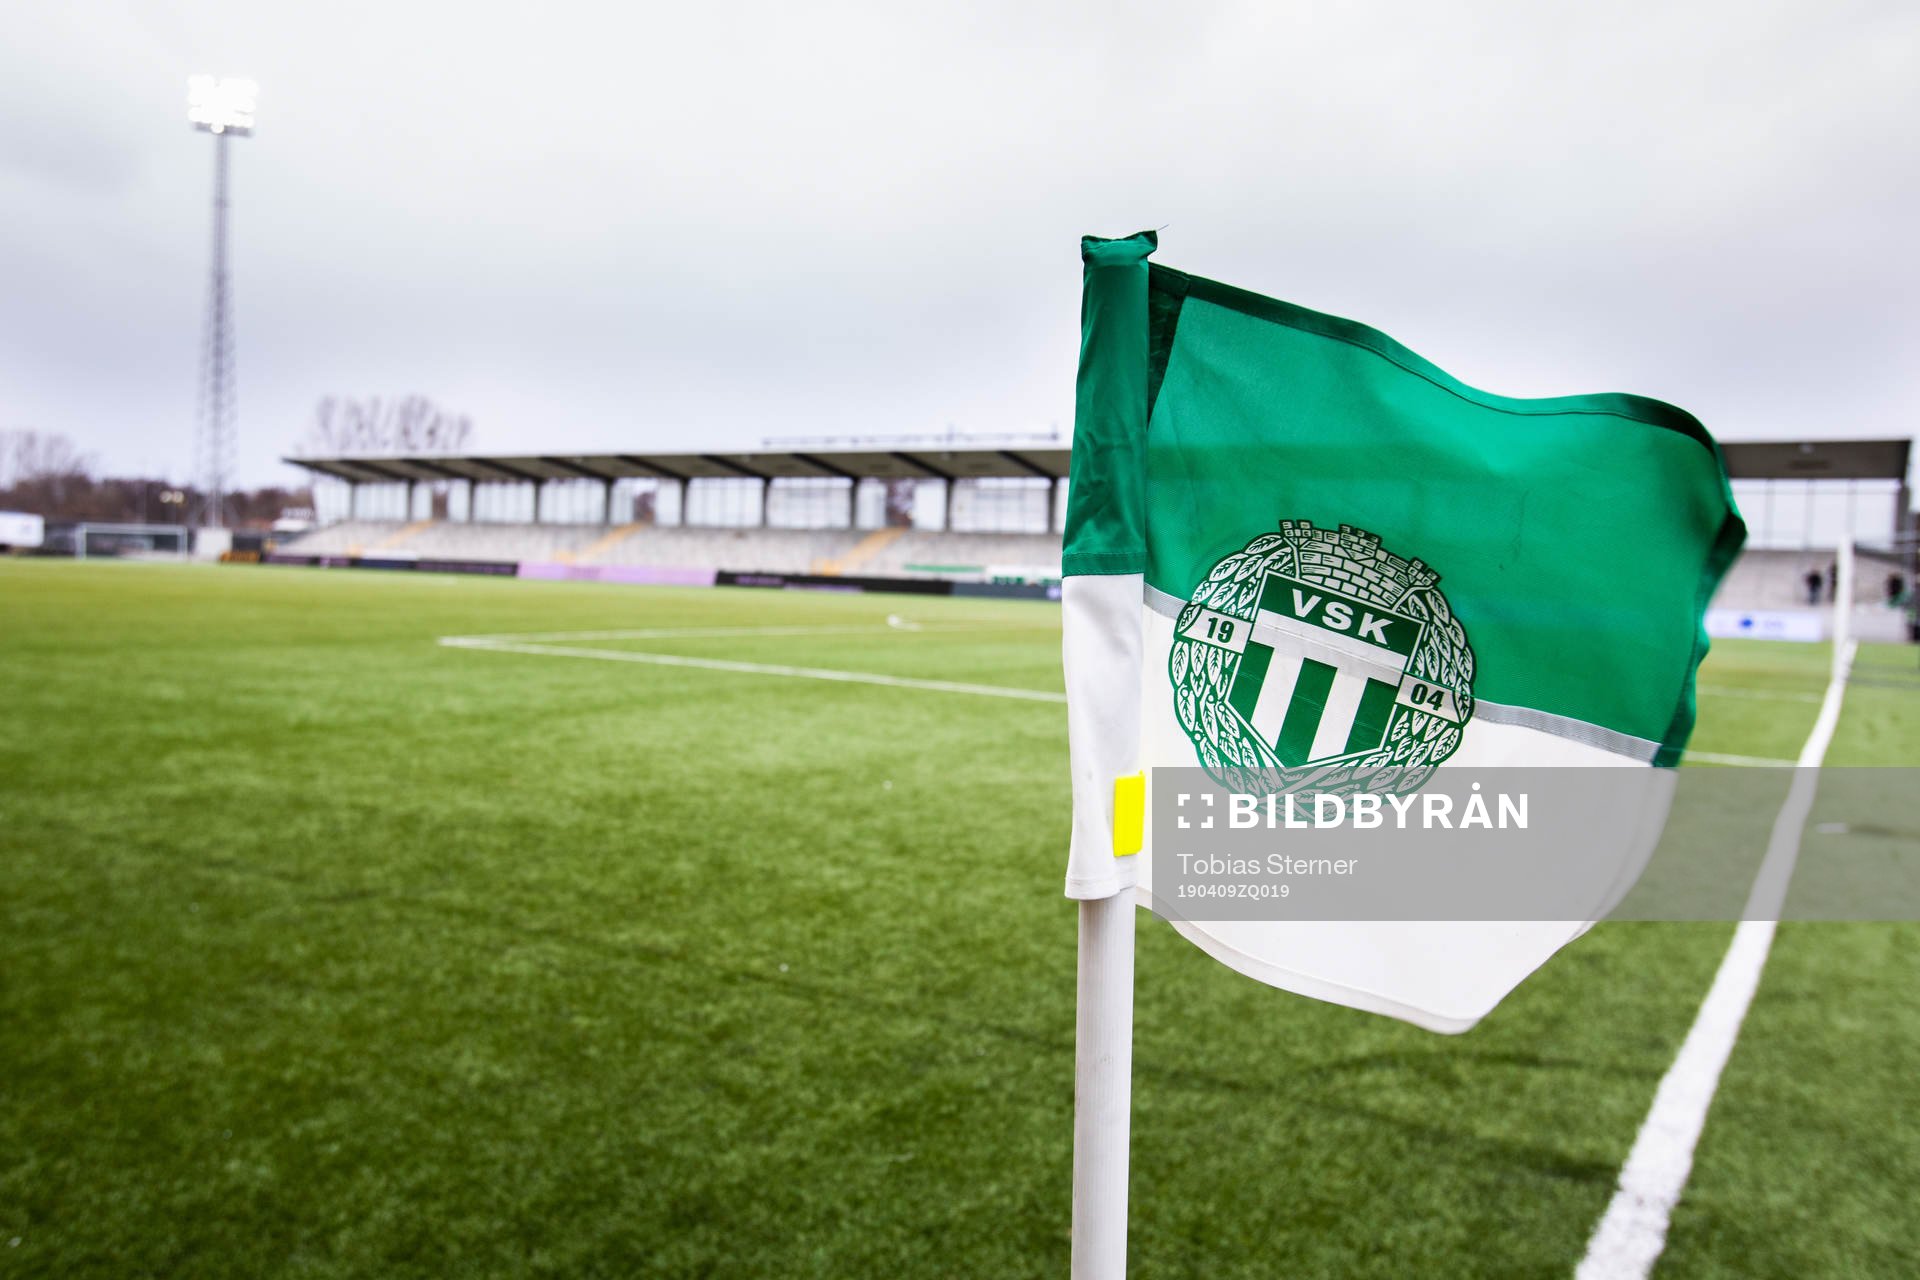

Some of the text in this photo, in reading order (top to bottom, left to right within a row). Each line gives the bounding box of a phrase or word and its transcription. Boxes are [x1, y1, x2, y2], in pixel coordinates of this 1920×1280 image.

[1207, 616, 1235, 643] 19
[1292, 589, 1394, 645] VSK
[1410, 683, 1444, 711] 04
